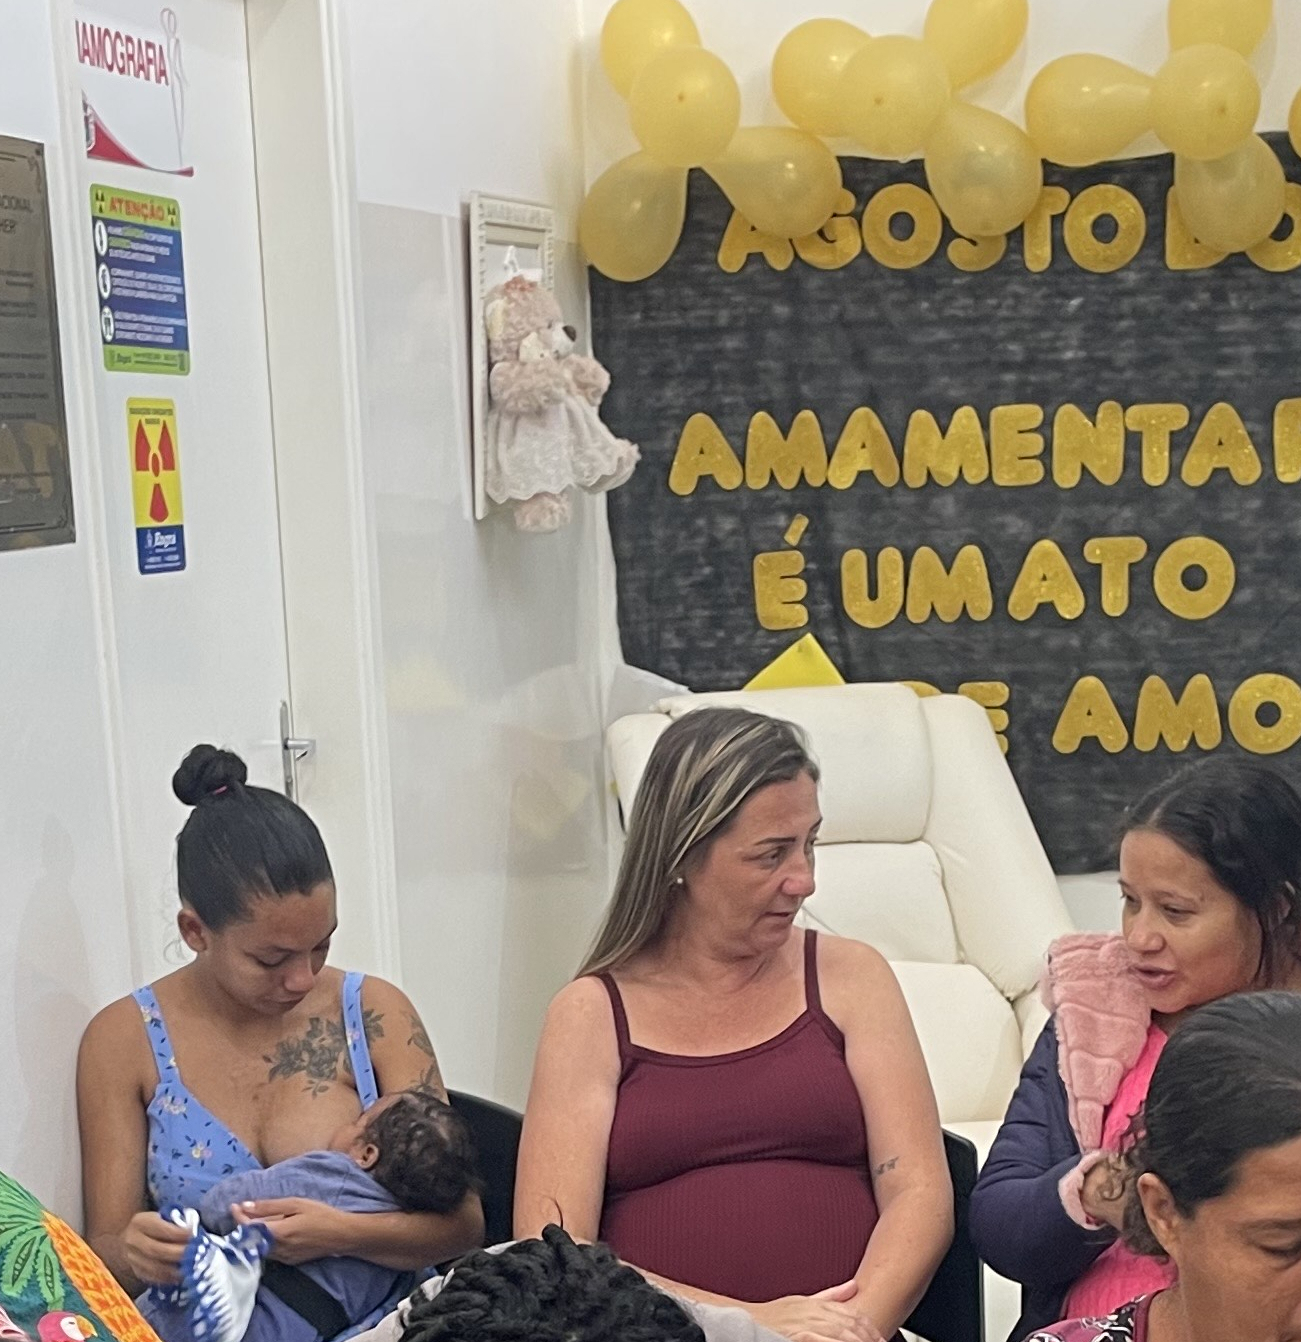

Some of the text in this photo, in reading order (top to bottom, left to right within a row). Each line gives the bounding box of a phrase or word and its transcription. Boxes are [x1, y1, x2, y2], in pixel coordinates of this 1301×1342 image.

[109, 196, 165, 221] ATENÇÃO
[753, 513, 1236, 630] É UM ATO
